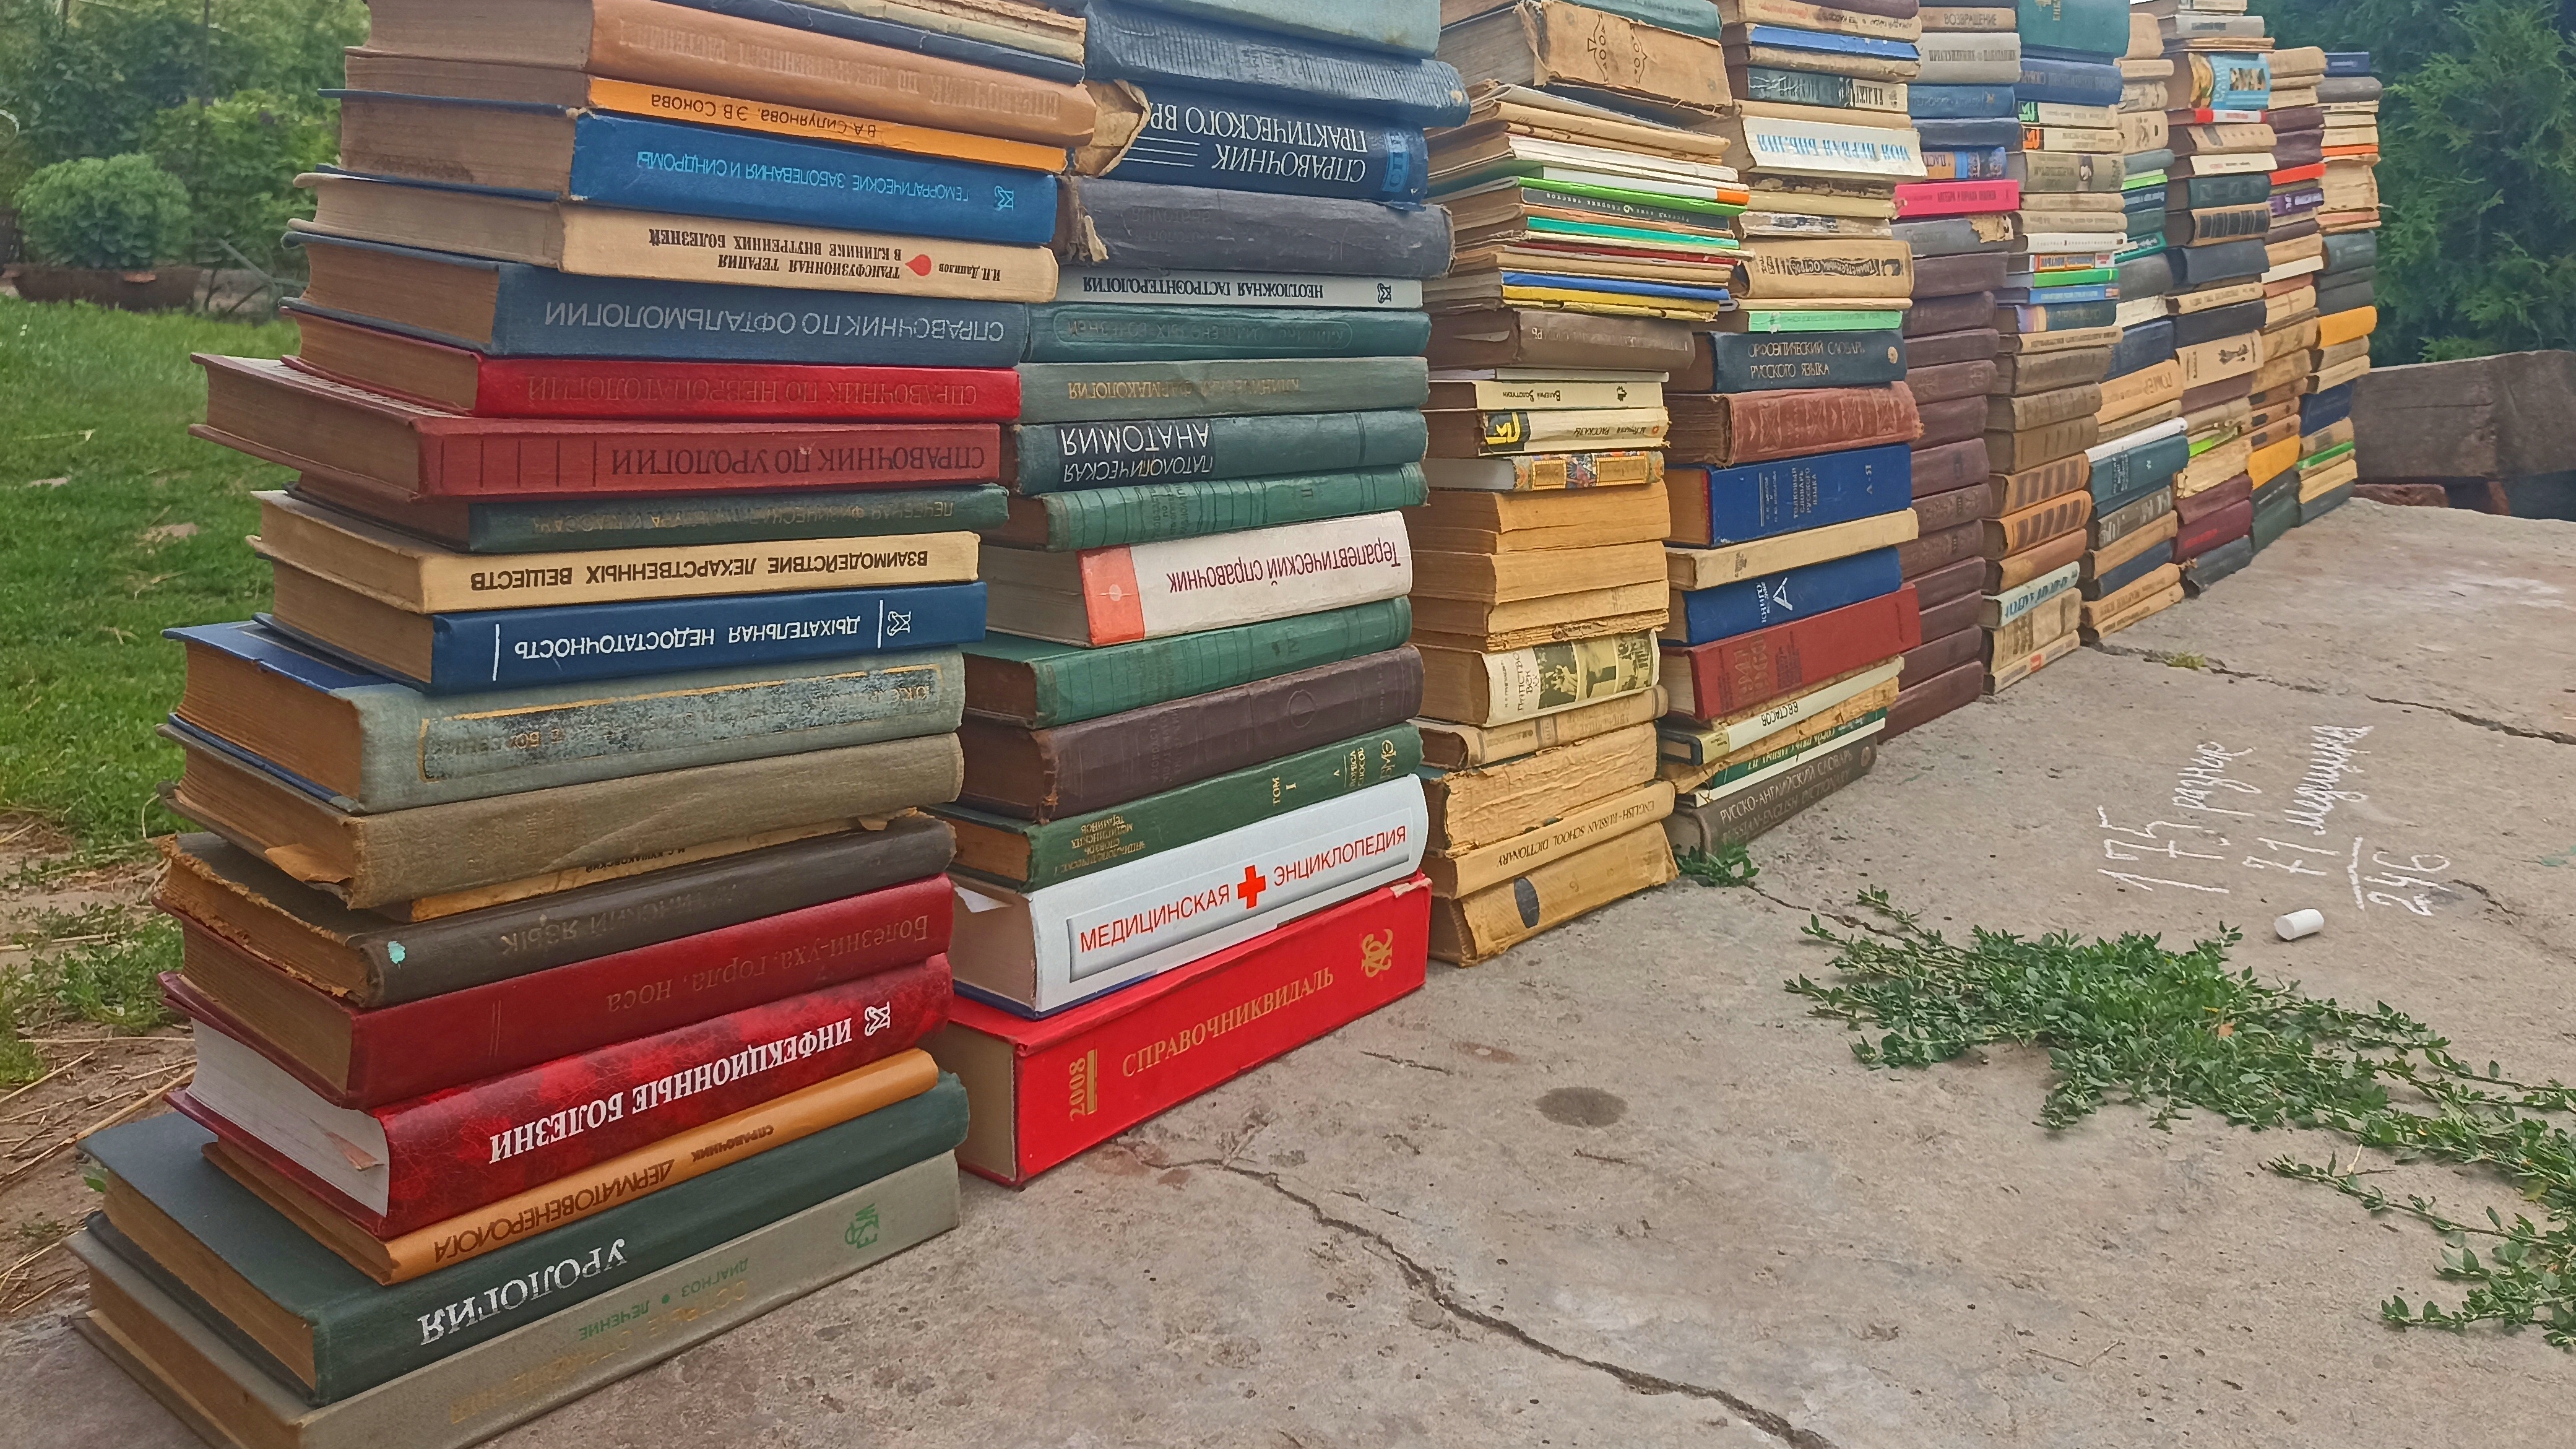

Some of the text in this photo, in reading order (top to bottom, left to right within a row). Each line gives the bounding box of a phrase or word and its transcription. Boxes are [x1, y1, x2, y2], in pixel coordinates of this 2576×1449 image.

[1944, 14, 1997, 25] ВОЗВРАЩЕНИЕ
[897, 71, 920, 95] ПО
[929, 76, 1060, 120] СПРАВОЧНИК
[651, 93, 716, 117] Сокова
[1186, 106, 1368, 152] ПРАКТИЧЕСКОГО
[1211, 144, 1366, 183] СПРАВОЧНИК
[1757, 134, 1911, 162] МОЯ ПЕРВАЯ БИБЛИЯ
[636, 152, 969, 202] ГЕМОРРАГИЧЕСКИЕ ЗАБОЛЕВАНИЯ И СИНДРОМЫ
[650, 228, 901, 261] В КЛИНИКЕ ВНУТРЕННИХ БОЛЕЗНЕЙ
[718, 254, 899, 279] ТРАНСФУЗИОННАЯ ТЕРАПИЯ
[939, 264, 979, 279] Данилов
[1083, 277, 1323, 298] НЕОТЛОЖНАЯ ГАСТРОЭНТЕРОЛОГИЯ
[545, 301, 1005, 341] СПРАВОЧНИК ПО ОФТАЛЬМОЛОГИИ
[1748, 341, 1823, 358] ОРФОЭПИЧЕСКИЙ
[1068, 379, 1192, 399] ФАРМАКОЛОГИЯ
[1750, 363, 1830, 379] РУССКОГО ЯЗЫКА
[786, 381, 817, 404] ПО
[827, 381, 977, 405] СПРАВОЧНИК
[1060, 423, 1209, 456] АНАТОМИЯ
[1573, 426, 1609, 435] РАССКАЗЫ
[612, 446, 984, 476] СПРАВОЧНИК ПО УРОЛОГИИ
[1063, 456, 1212, 482] ПАТОЛОГИЧЕСКАЯ
[470, 550, 928, 589] ВЗАИМОДЕЙСТВИЕ ЛЕКАРСТВЕННЫХ ВЕЩЕСТВ
[1166, 537, 1401, 593] Терапевтический справочник
[515, 615, 860, 659] ДЫХАТЕЛЬНАЯ НЕДОСТАТОЧНОСТЬ
[1513, 651, 1525, 712] ПАПСТВО
[1719, 750, 1852, 824] РУССКО-АНГЛИЙСКИЙ СЛОВАРЬ
[1497, 839, 1549, 868] DICTIONARY
[1552, 826, 1585, 846] SCHOOL
[2097, 805, 2231, 894] 175
[2242, 836, 2341, 876] 71
[1081, 825, 1407, 953] МЕДИЦИНСКАЯ ЭНЦИКЛОПЕДИЯ
[2364, 850, 2451, 917] 246
[607, 979, 672, 1016] носа
[490, 1018, 852, 1162] ИНФЕКЦИОННЫЕ БОЛЕЗНИ
[1069, 1057, 1086, 1122] 2008
[434, 1125, 774, 1261] СПРАВОЧНИК ДЕРМАТОВЕНЕРОЛОГА
[418, 1238, 628, 1346] УРОЛОГИЯ
[681, 1258, 748, 1296] ДИАГНОЗ
[577, 1302, 650, 1341] ЛЕЧЕНИЕ
